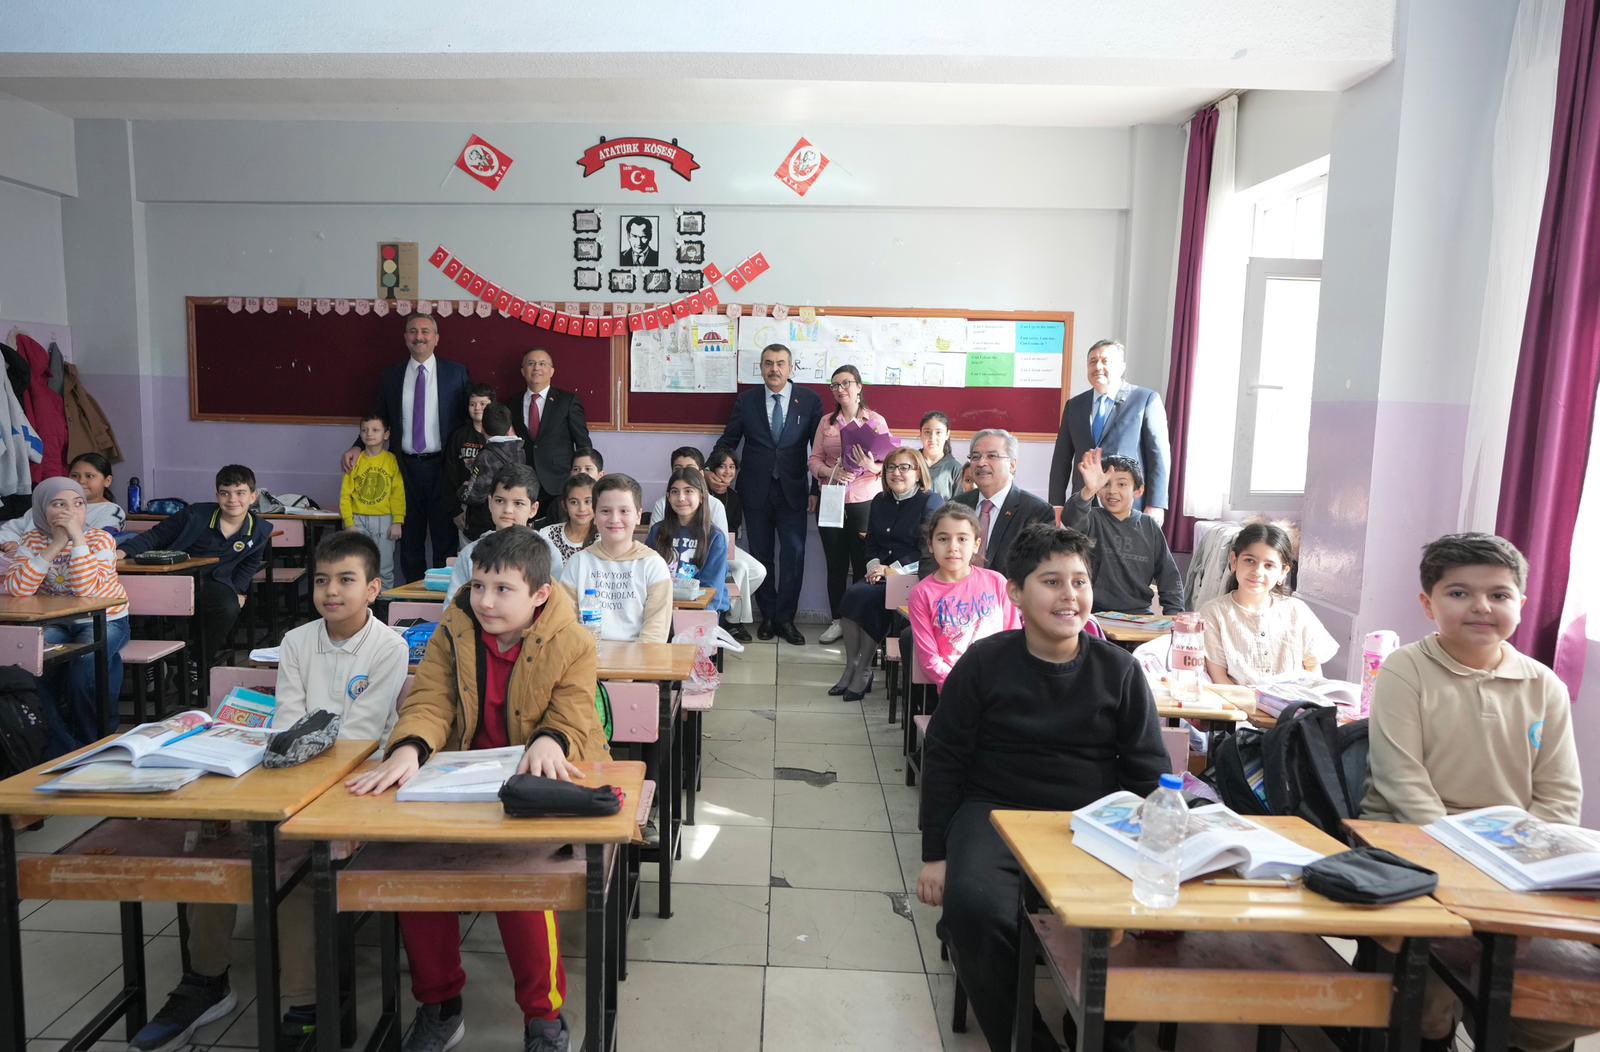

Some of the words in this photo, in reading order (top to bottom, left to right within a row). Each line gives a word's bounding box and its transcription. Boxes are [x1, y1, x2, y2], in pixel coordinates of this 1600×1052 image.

[600, 143, 640, 160] ATATÜRK
[644, 144, 676, 158] KÖŞESİ
[591, 570, 610, 579] NEW
